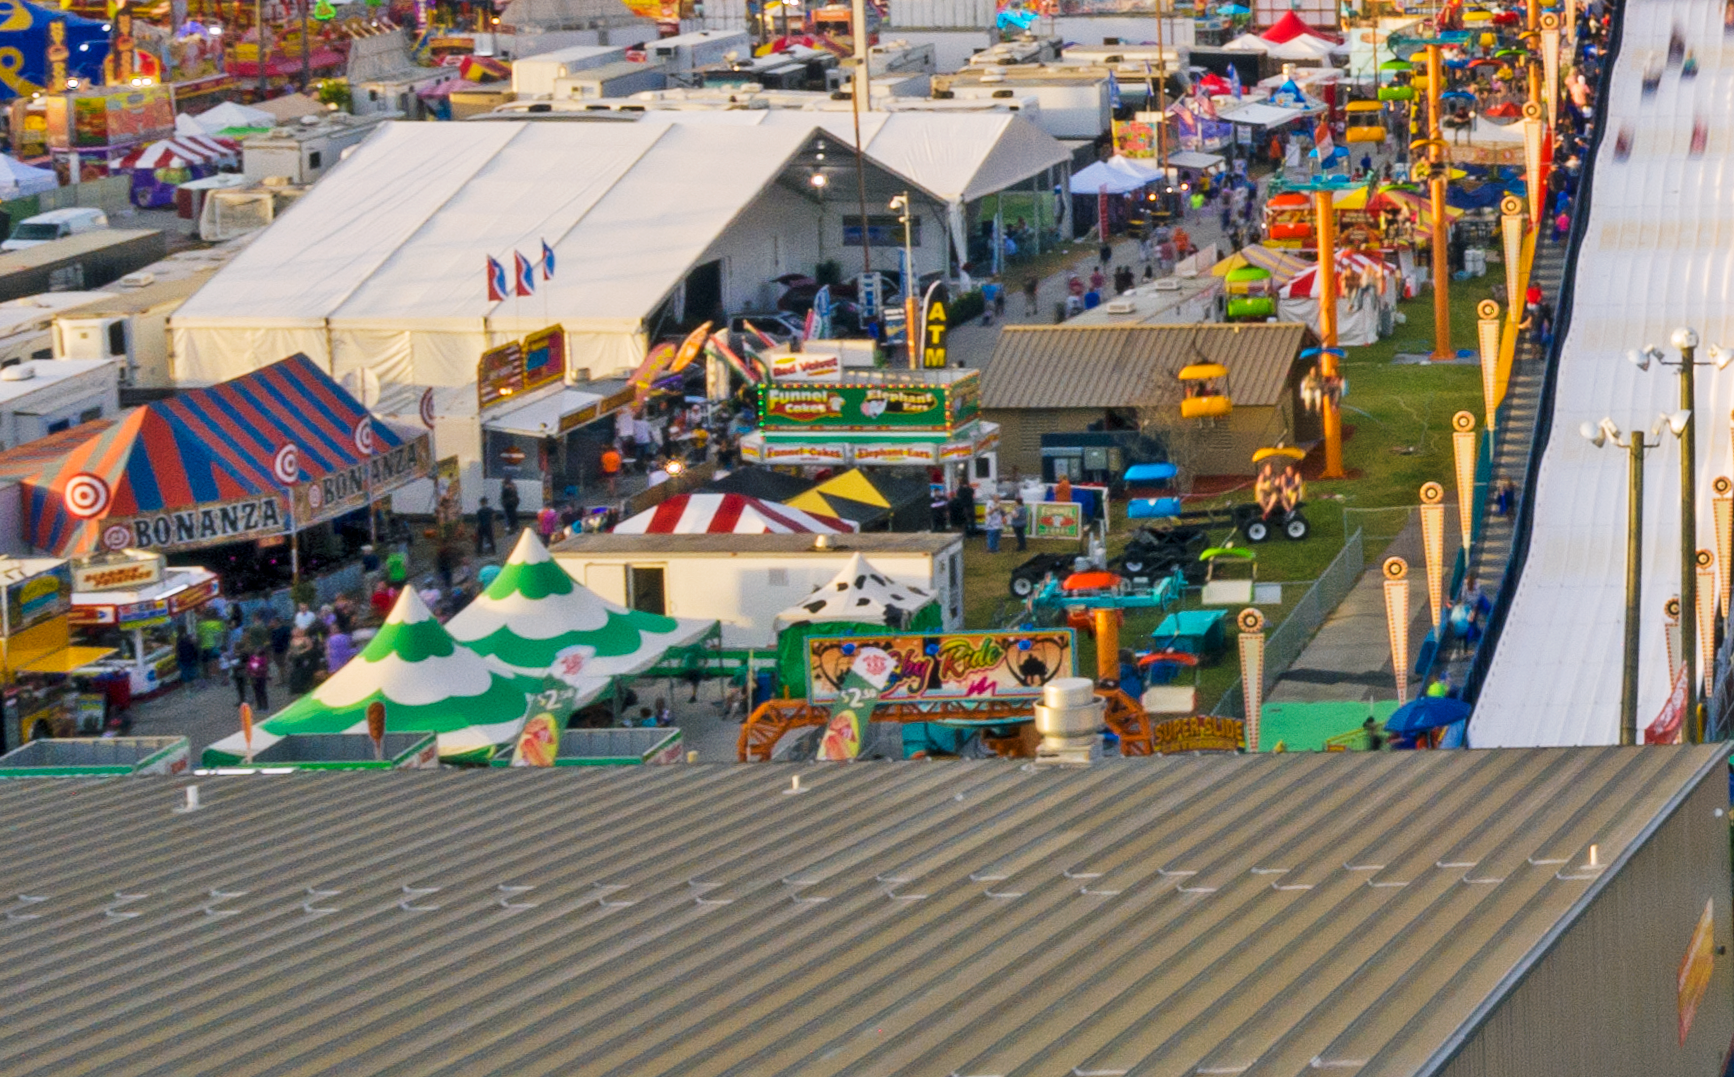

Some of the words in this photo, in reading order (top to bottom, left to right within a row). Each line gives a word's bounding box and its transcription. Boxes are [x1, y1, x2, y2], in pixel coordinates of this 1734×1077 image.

[924, 301, 947, 367] ATM
[773, 364, 796, 377] Red
[768, 389, 828, 405] Funnel
[866, 390, 933, 404] Elephant
[784, 402, 827, 414] Cakes
[902, 401, 929, 412] Ears
[322, 442, 418, 506] BONANZA
[134, 498, 281, 549] BONANZA
[939, 635, 1005, 680] Ride
